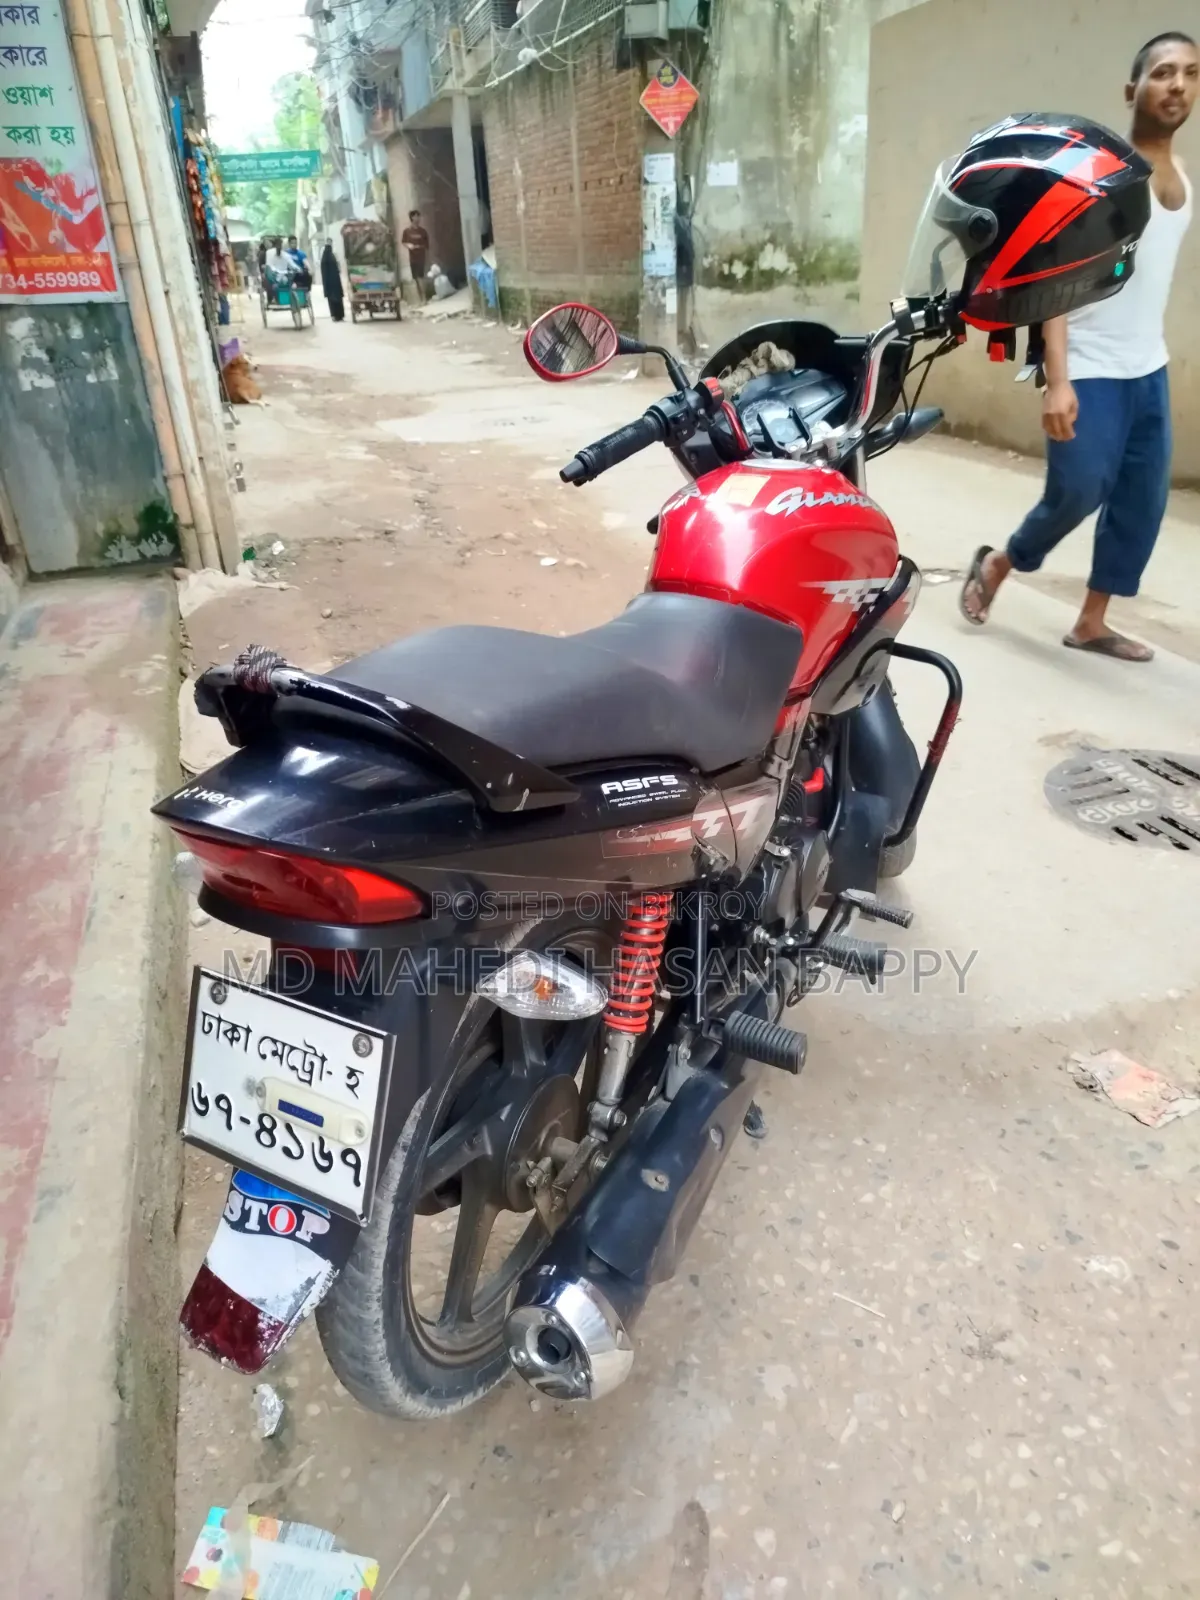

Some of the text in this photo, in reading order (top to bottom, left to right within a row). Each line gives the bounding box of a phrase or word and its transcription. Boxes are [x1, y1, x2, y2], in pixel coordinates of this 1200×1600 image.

[0, 4, 40, 27] কার
[0, 44, 48, 69] কারে
[1, 83, 55, 107] ওয়াশ
[1, 123, 76, 148] করা হয়
[0, 270, 102, 290] 34-559989
[600, 774, 679, 795] ASFS
[195, 789, 248, 809] Hero
[200, 1008, 253, 1054] ঢাকা
[345, 1064, 366, 1100] হ
[190, 1080, 363, 1188] ৬৭-৪১৬৭
[223, 1189, 332, 1244] STOP
